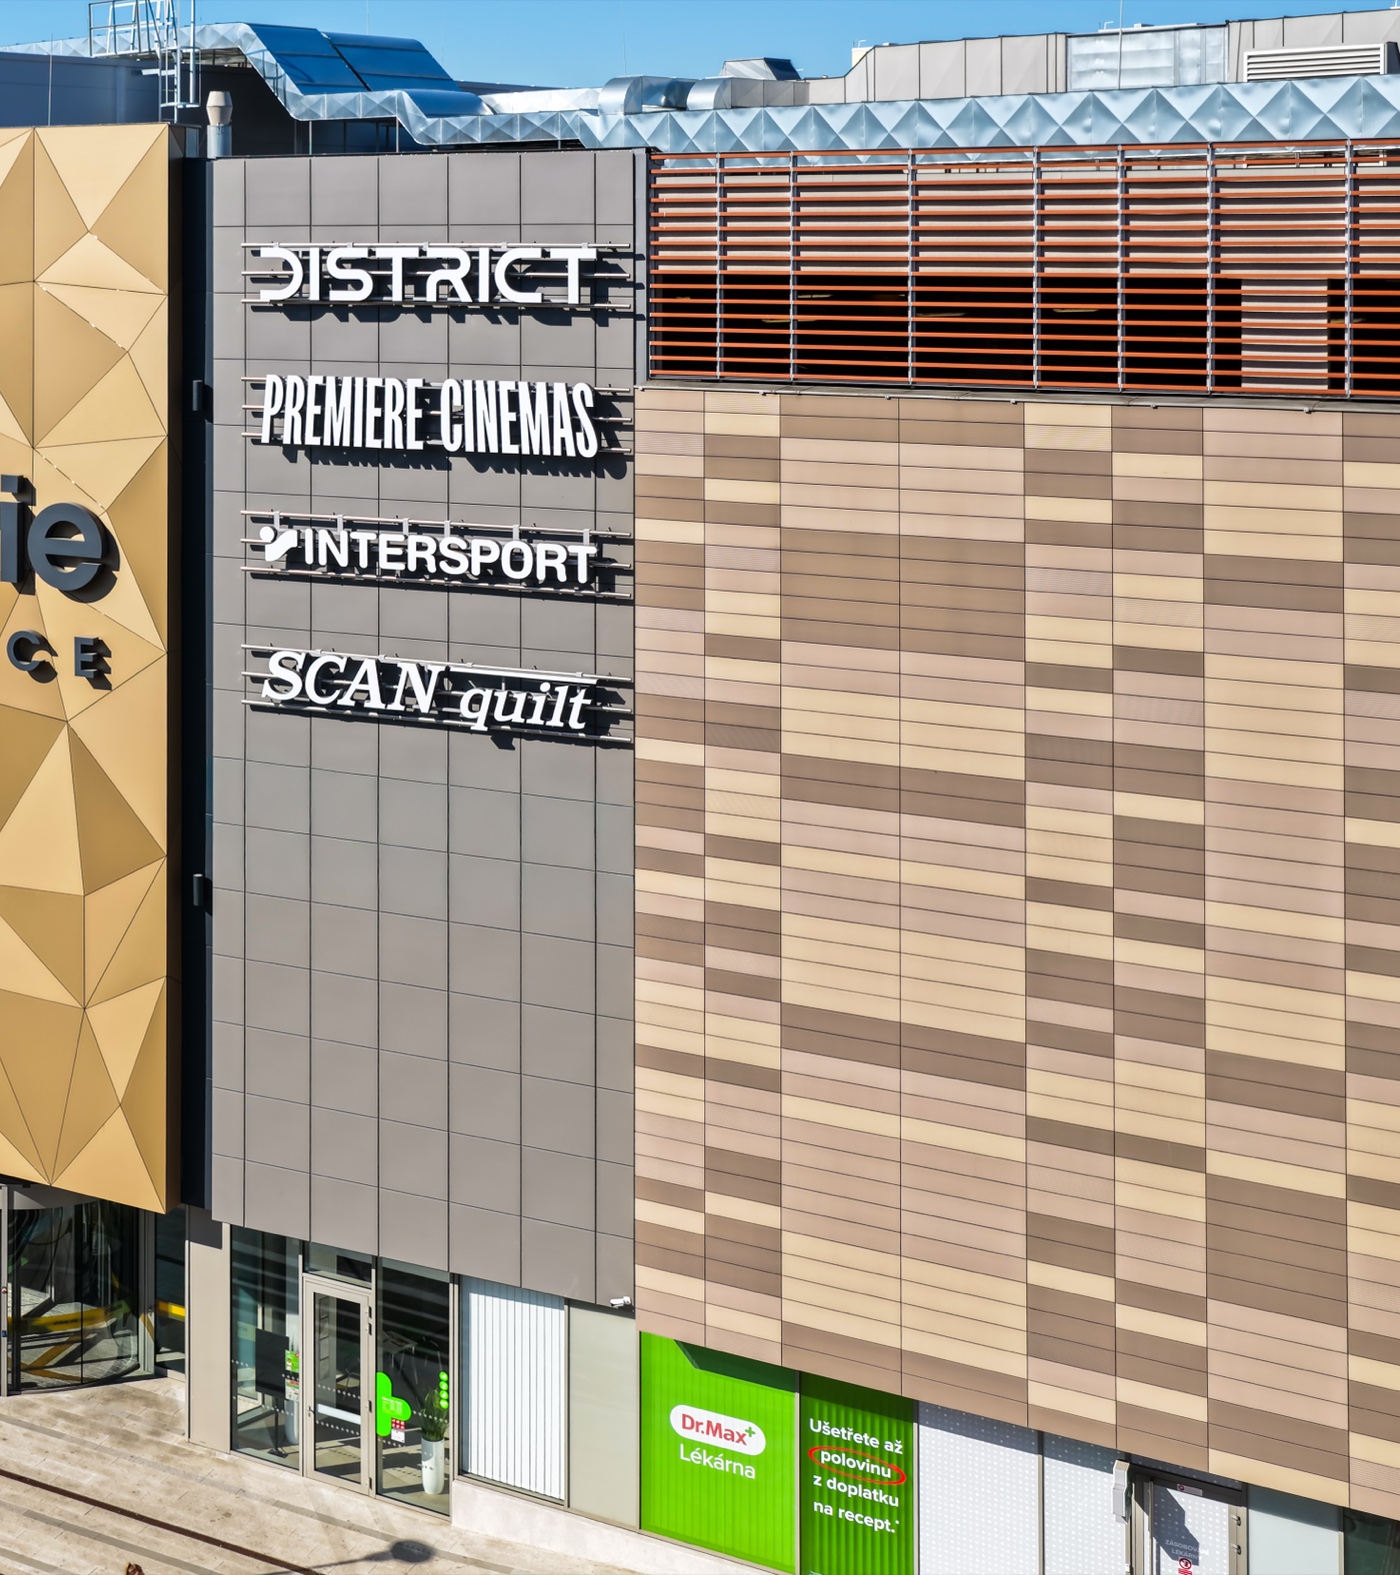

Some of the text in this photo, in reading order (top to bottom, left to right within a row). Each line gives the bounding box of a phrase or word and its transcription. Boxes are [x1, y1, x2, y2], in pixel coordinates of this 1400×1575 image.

[260, 247, 597, 304] DISTRICT
[261, 374, 598, 458] PREMIERE CINEMAS
[305, 527, 597, 584] INTERSPORT
[261, 650, 595, 732] SCAN quilt
[809, 1418, 903, 1455] Ušetřete až
[680, 1443, 756, 1480] Lékárna
[820, 1450, 891, 1479] polovinu
[813, 1475, 899, 1507] z doplatku
[813, 1501, 833, 1516] na
